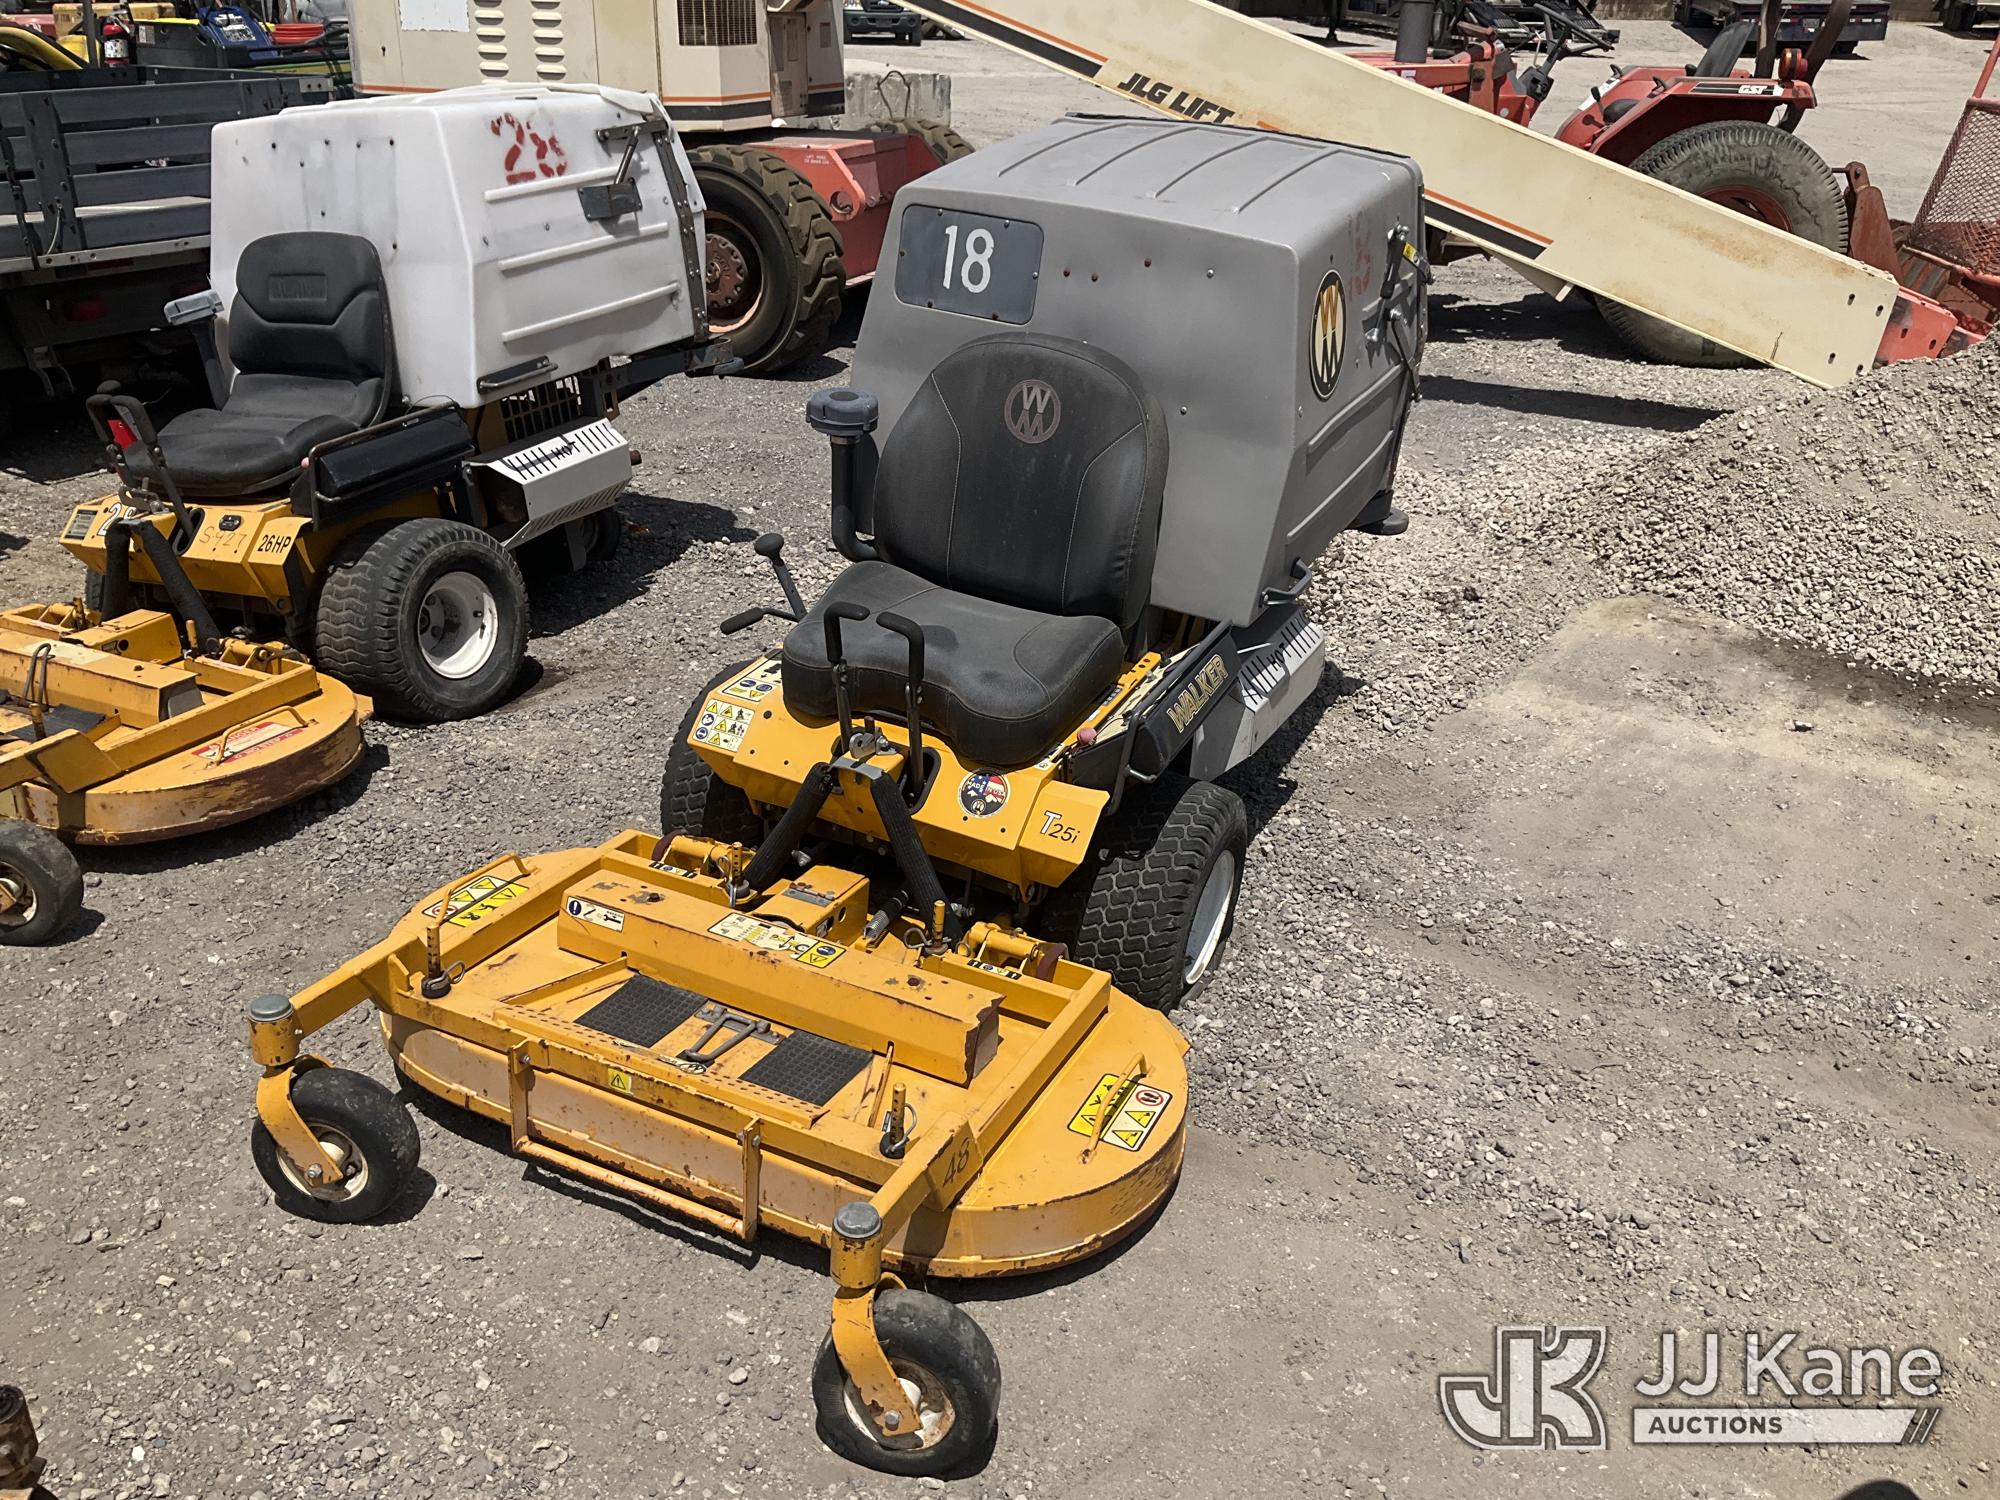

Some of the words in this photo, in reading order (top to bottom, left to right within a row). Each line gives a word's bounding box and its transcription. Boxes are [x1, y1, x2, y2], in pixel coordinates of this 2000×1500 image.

[1117, 72, 1173, 104] JLG
[1169, 91, 1236, 123] LIFT
[1738, 84, 1768, 94] GST
[942, 225, 995, 293] 18
[1166, 653, 1229, 734] WALKER
